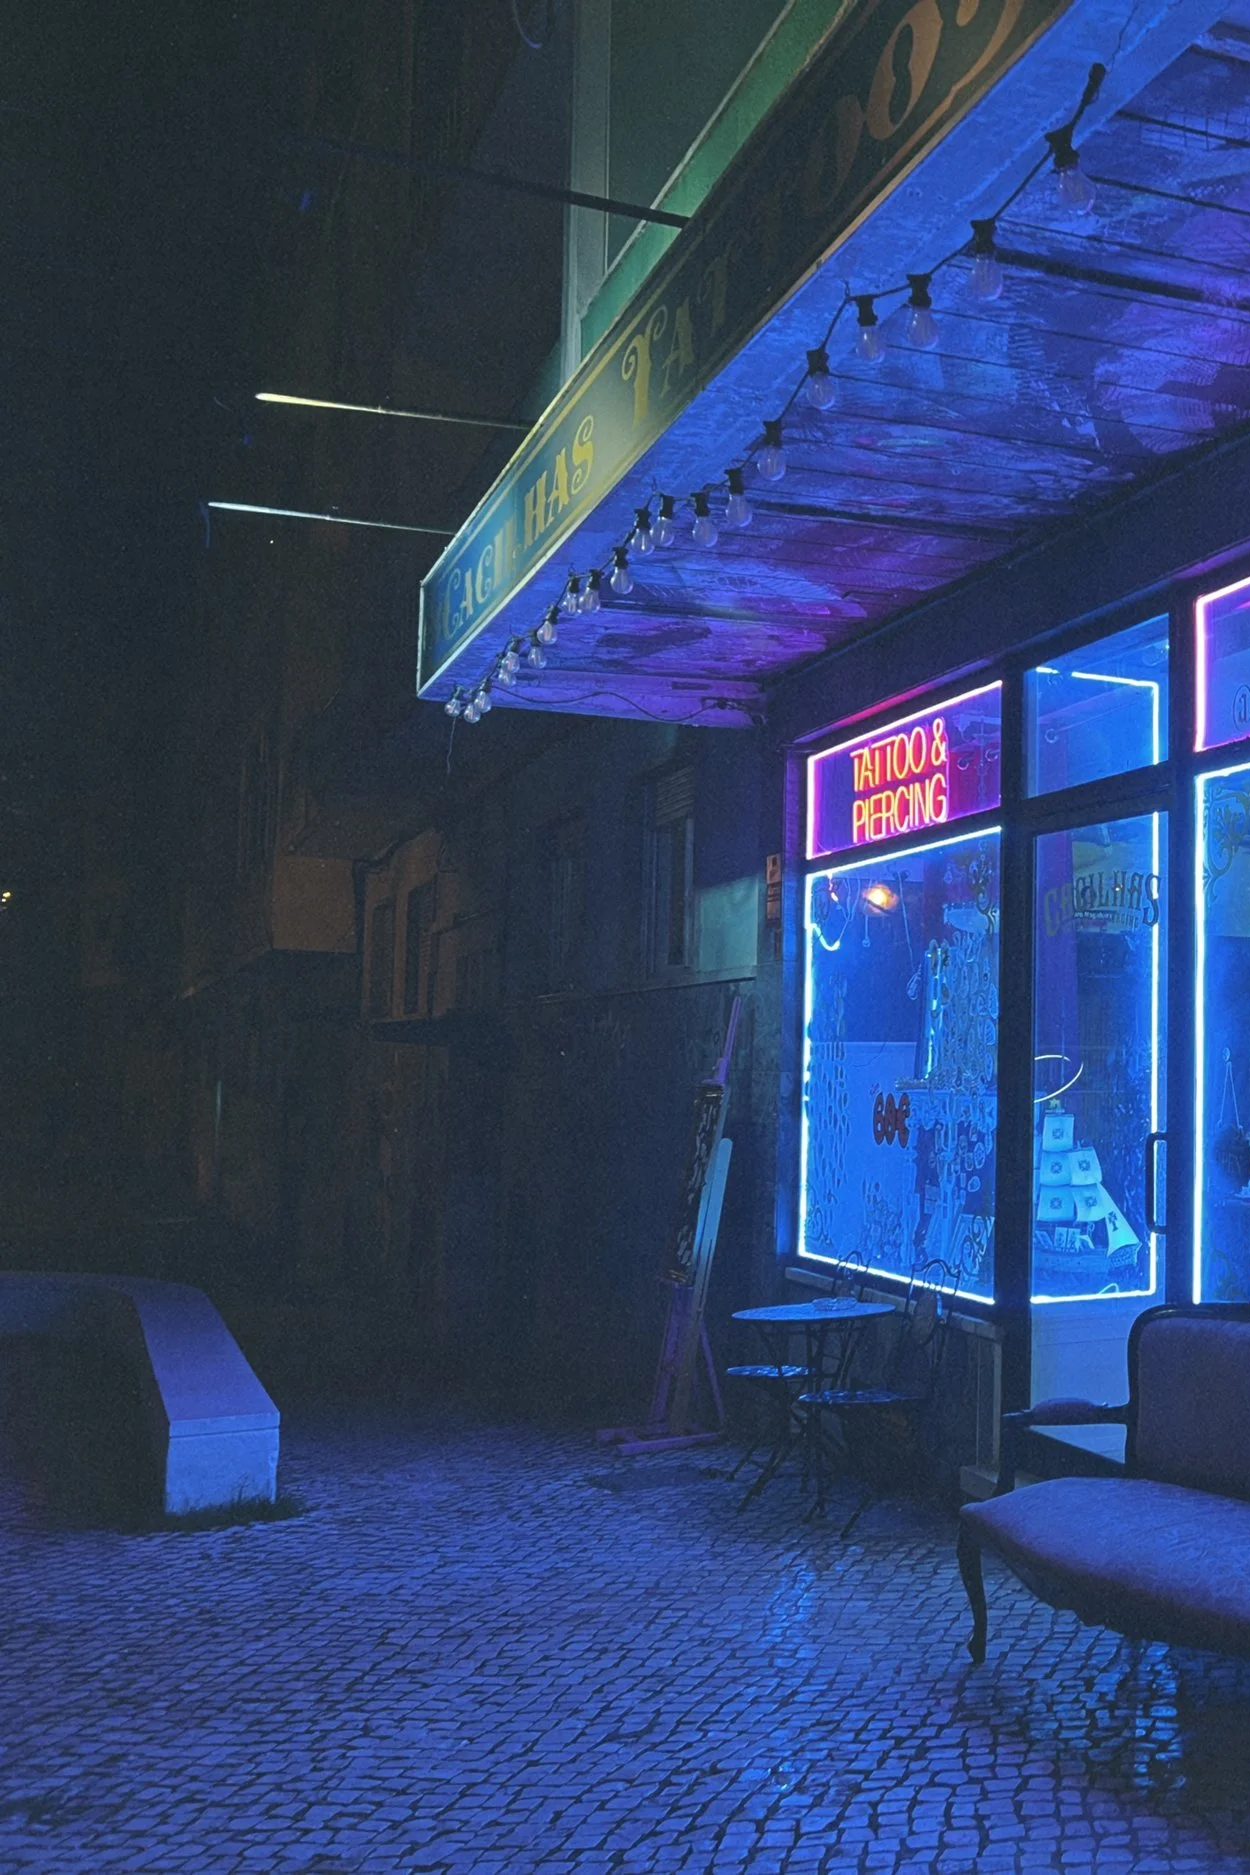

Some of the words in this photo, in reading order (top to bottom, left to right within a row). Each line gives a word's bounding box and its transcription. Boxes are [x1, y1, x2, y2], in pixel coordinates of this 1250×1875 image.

[850, 726, 926, 792] TATTOO
[931, 718, 947, 765] &
[853, 773, 948, 843] PIERCING
